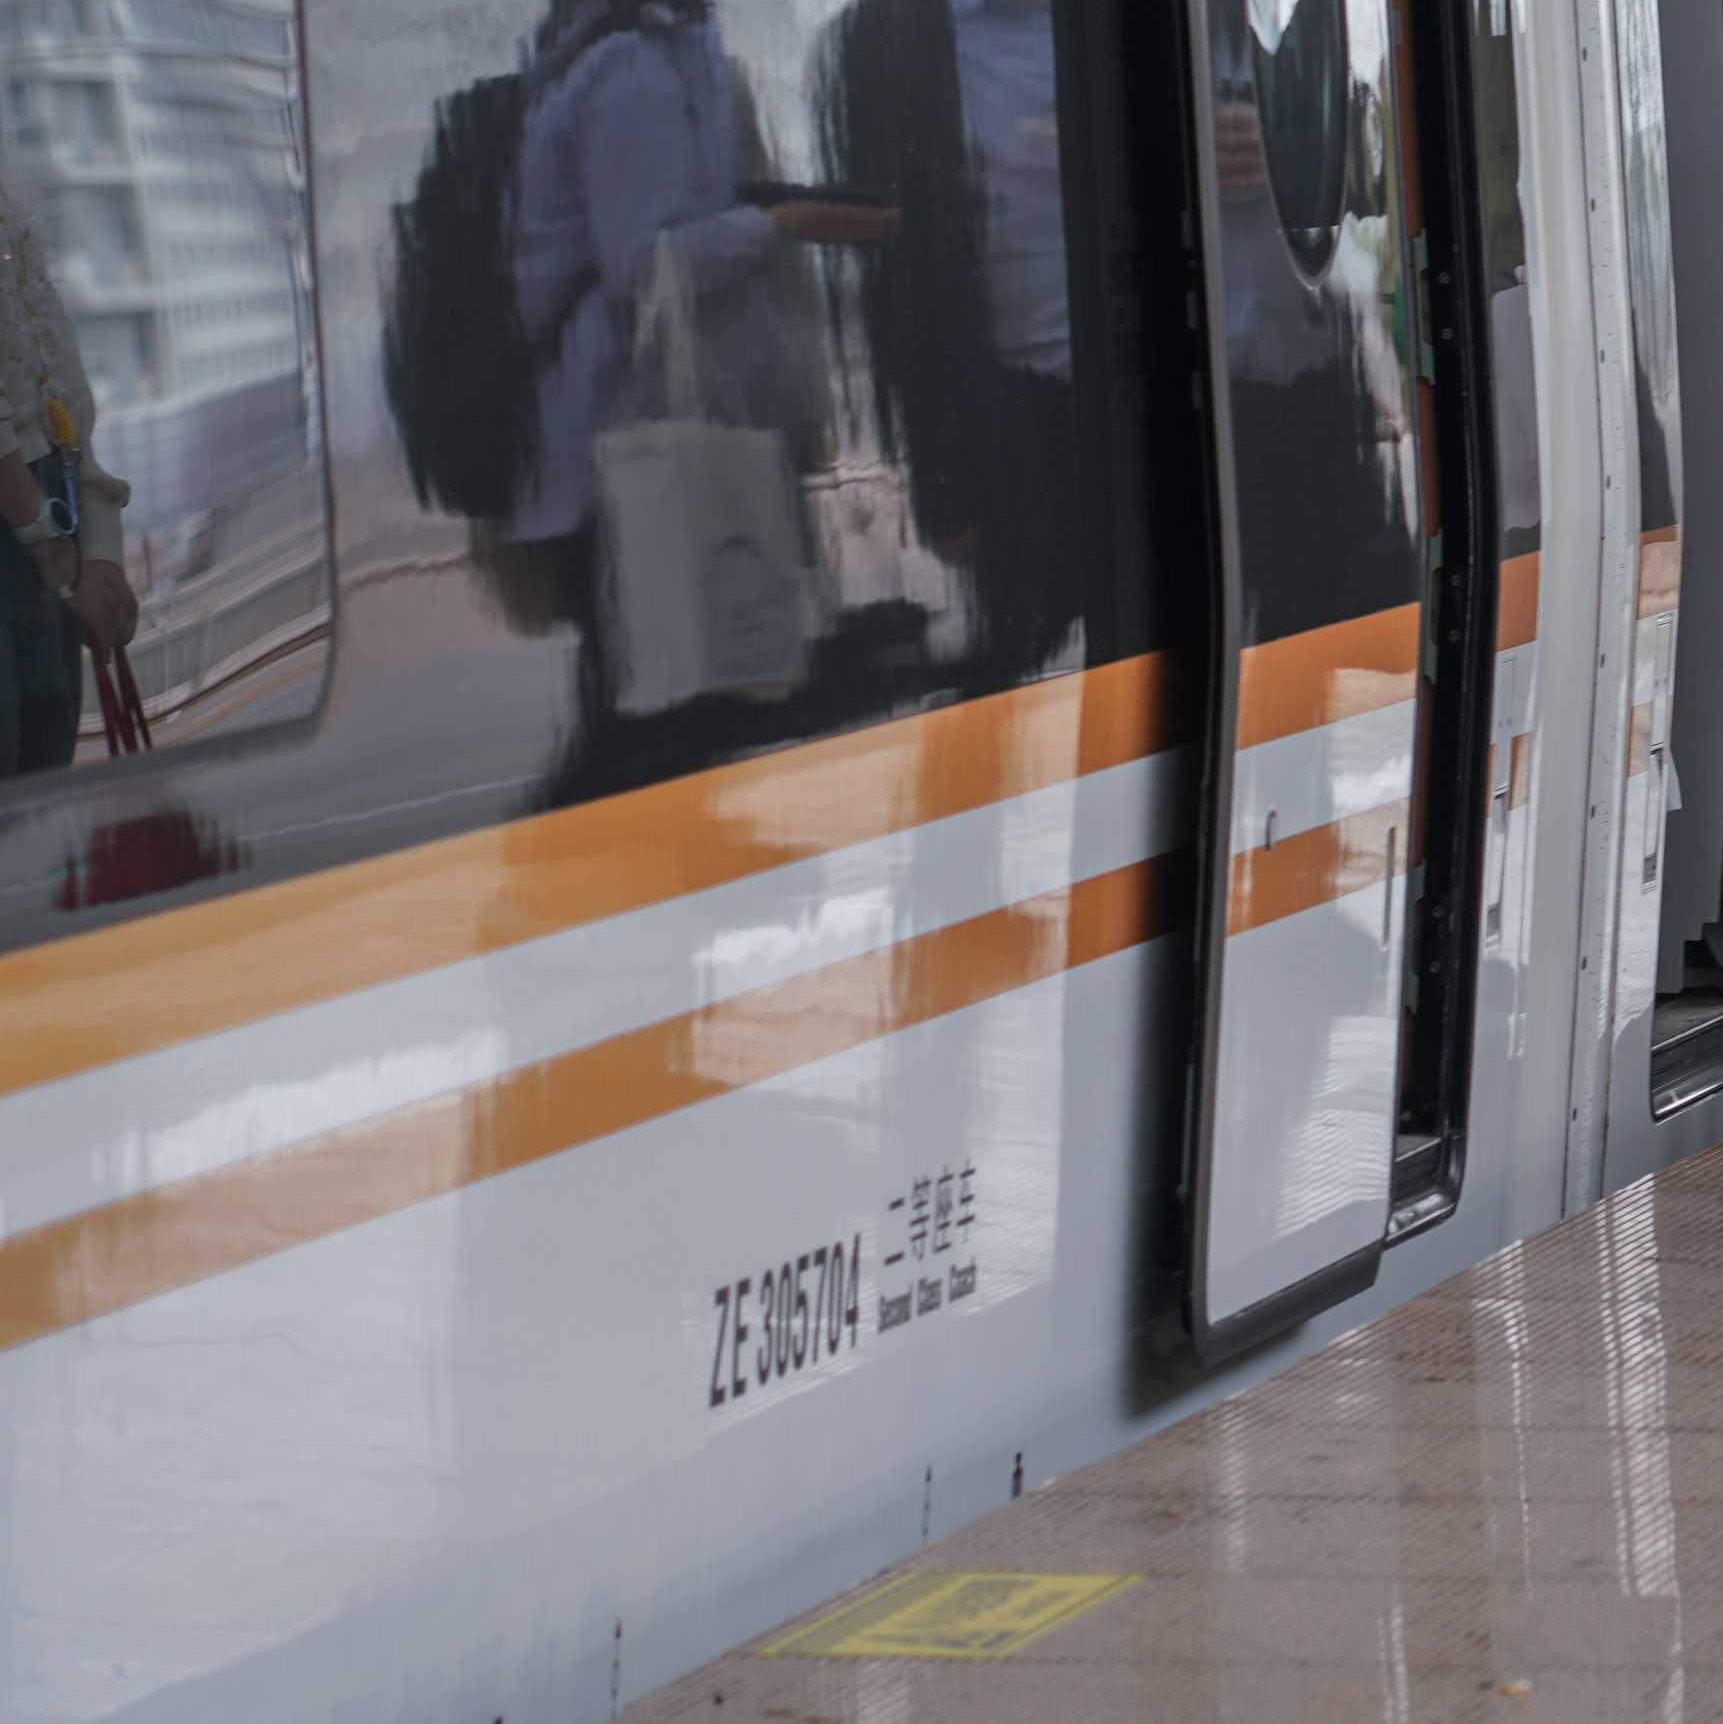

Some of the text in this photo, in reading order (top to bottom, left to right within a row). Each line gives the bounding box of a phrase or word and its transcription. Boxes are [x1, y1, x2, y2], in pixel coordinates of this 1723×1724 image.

[884, 1158, 977, 1266] 二等座车
[710, 1232, 861, 1408] ZE 305704
